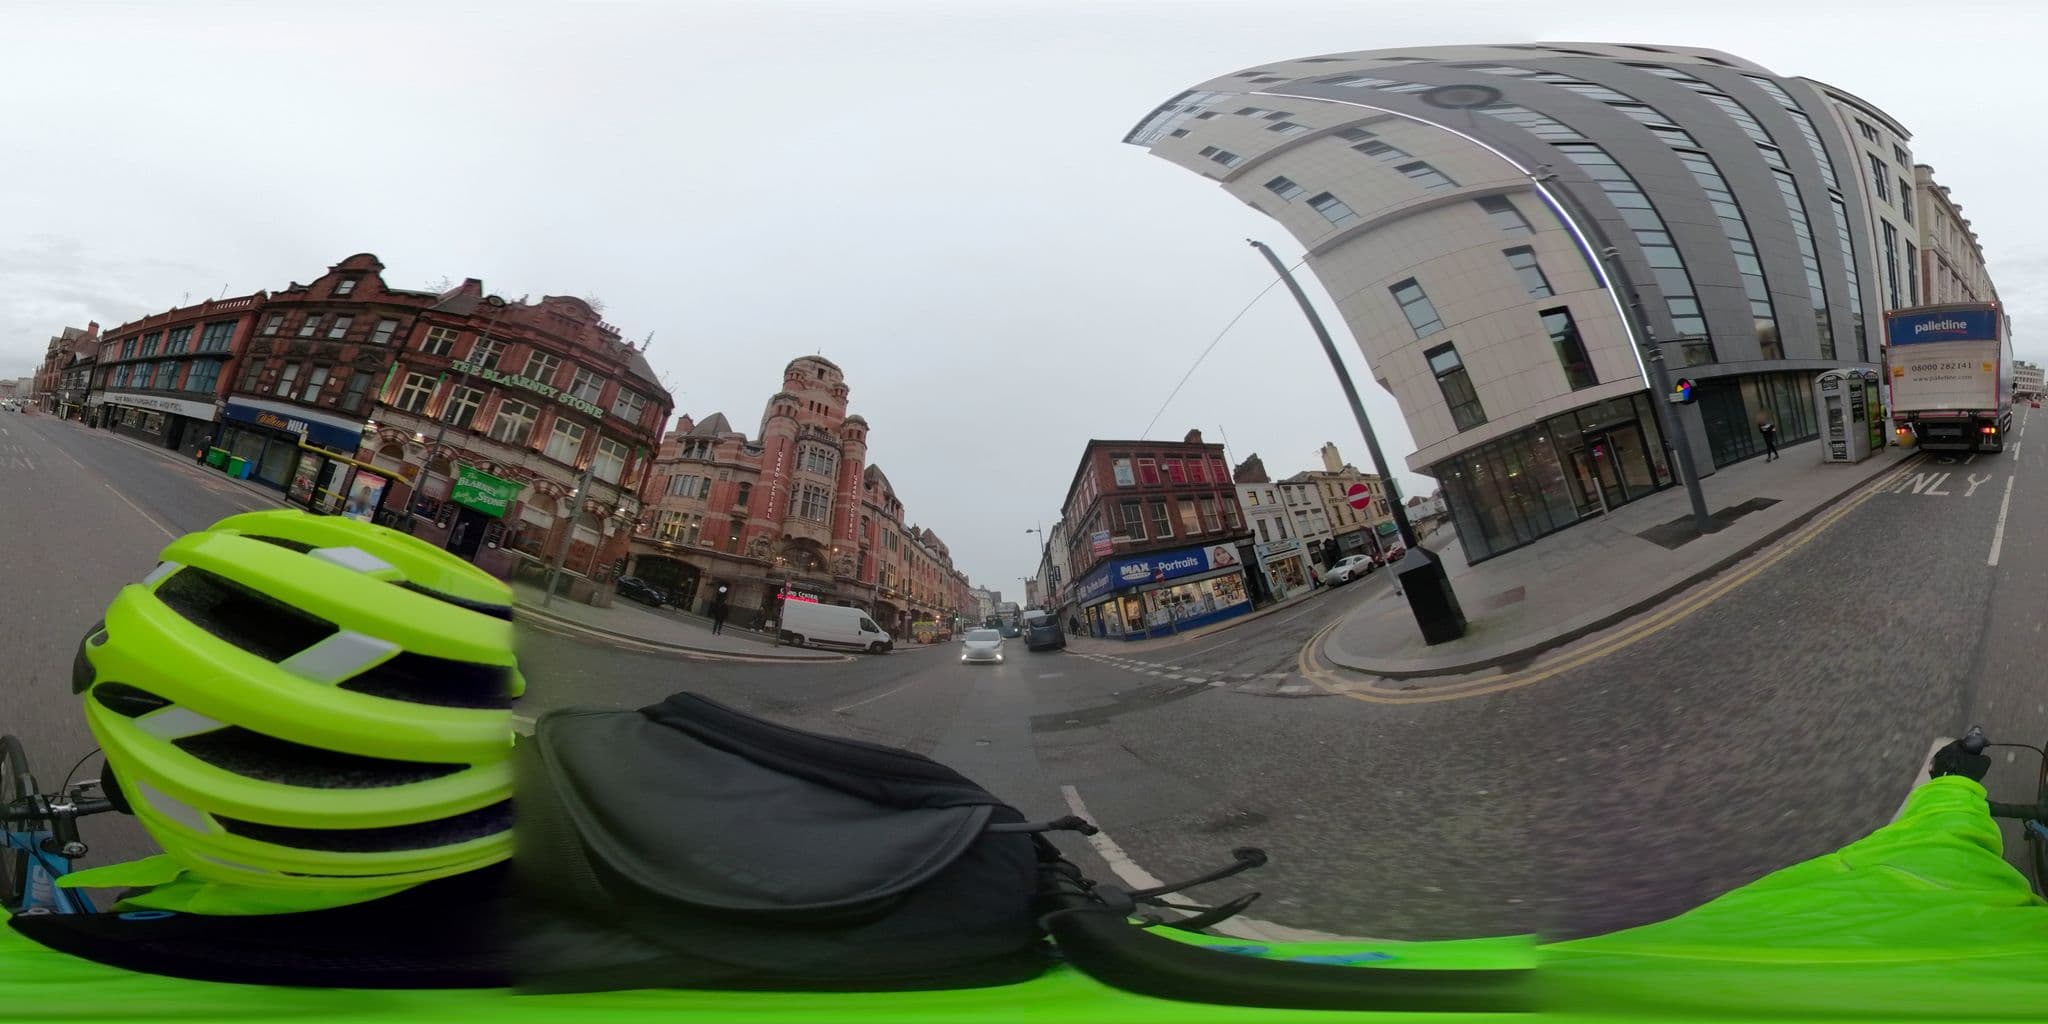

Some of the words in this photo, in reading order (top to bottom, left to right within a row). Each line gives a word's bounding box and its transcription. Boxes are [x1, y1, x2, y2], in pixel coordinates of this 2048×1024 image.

[1915, 320, 1967, 334] palletline
[1912, 363, 1937, 372] 08000
[451, 360, 481, 376] THE
[558, 392, 603, 418] STONE
[287, 419, 309, 434] HILL
[1121, 563, 1150, 575] MAX
[1159, 557, 1198, 572] Portraits
